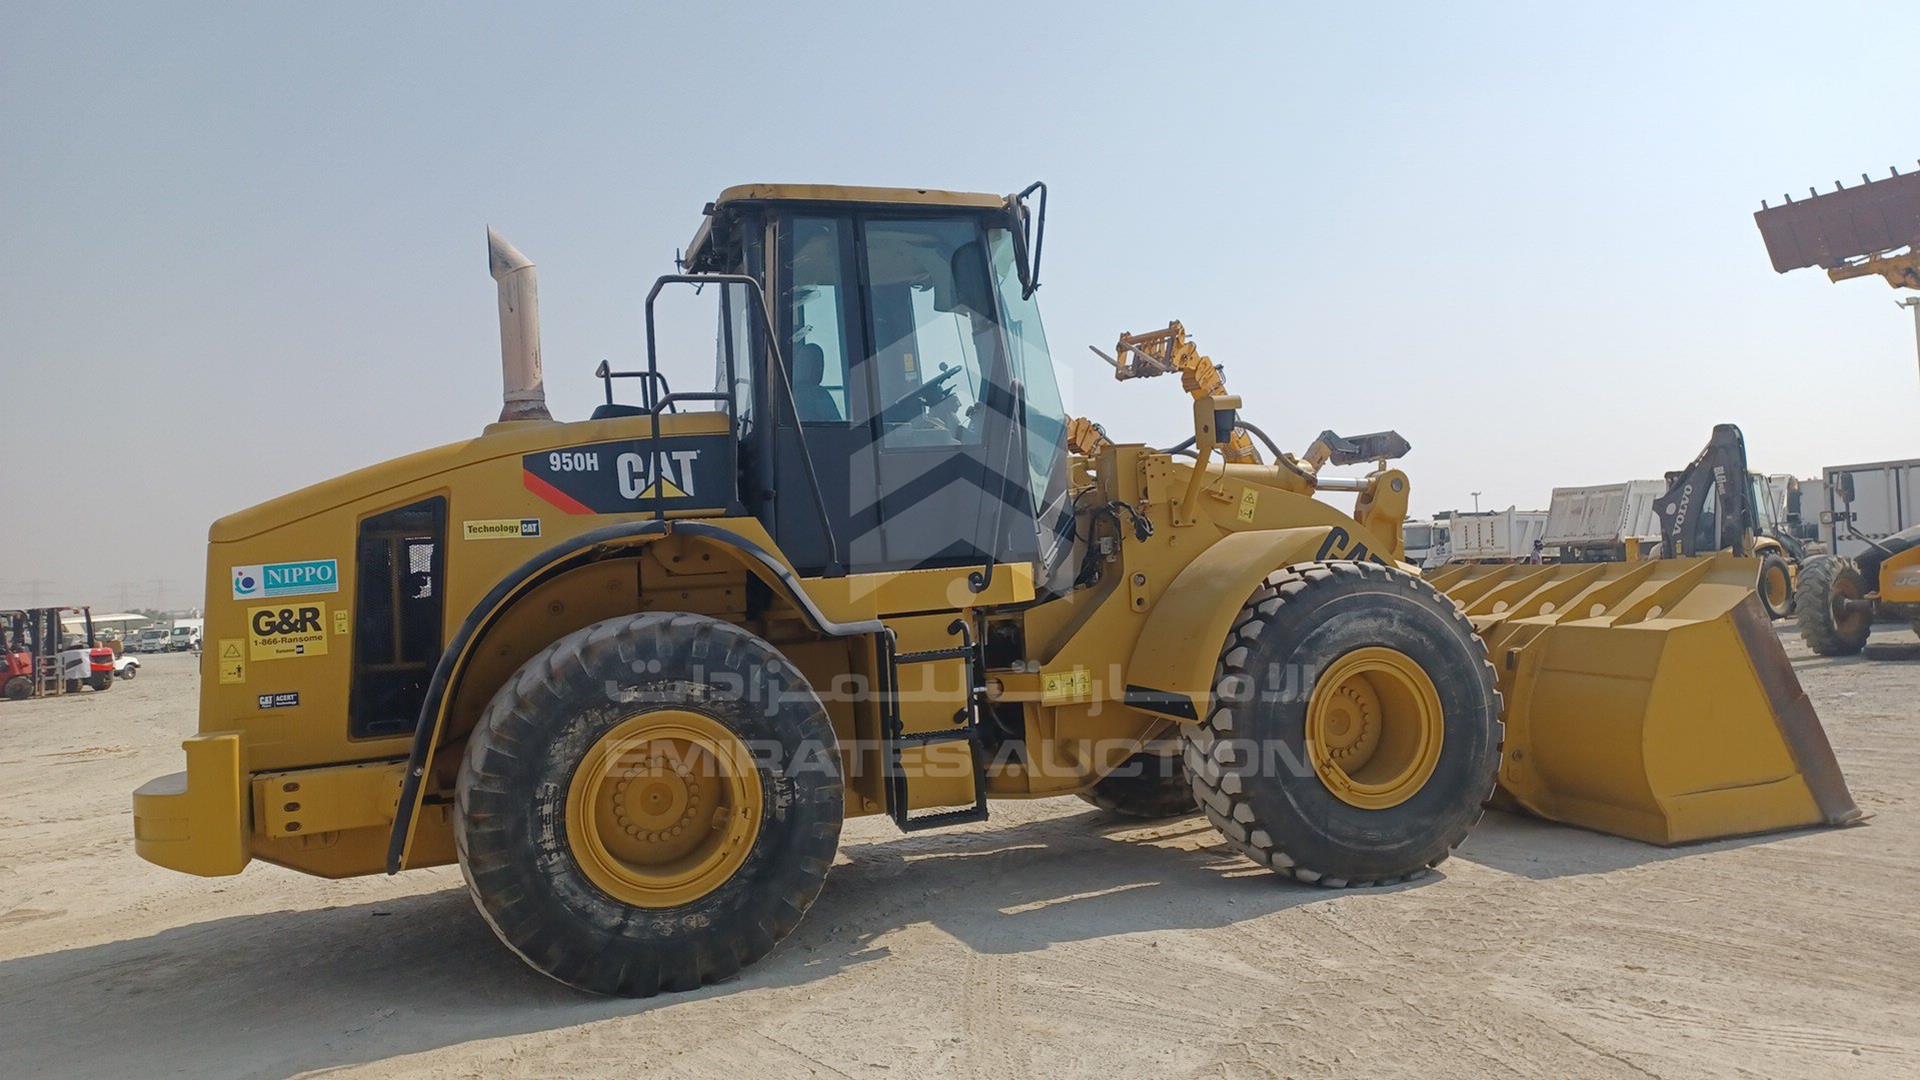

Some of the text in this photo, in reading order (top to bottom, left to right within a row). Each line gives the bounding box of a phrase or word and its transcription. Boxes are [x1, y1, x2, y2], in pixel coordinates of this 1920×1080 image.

[550, 452, 599, 471] 950H
[617, 450, 698, 500] CAT
[1672, 484, 1693, 537] VOLVO
[467, 522, 538, 534] Technology CAT
[268, 565, 332, 585] NIPPO
[252, 606, 322, 637] G&R
[254, 635, 323, 646] 1-866-Ransome
